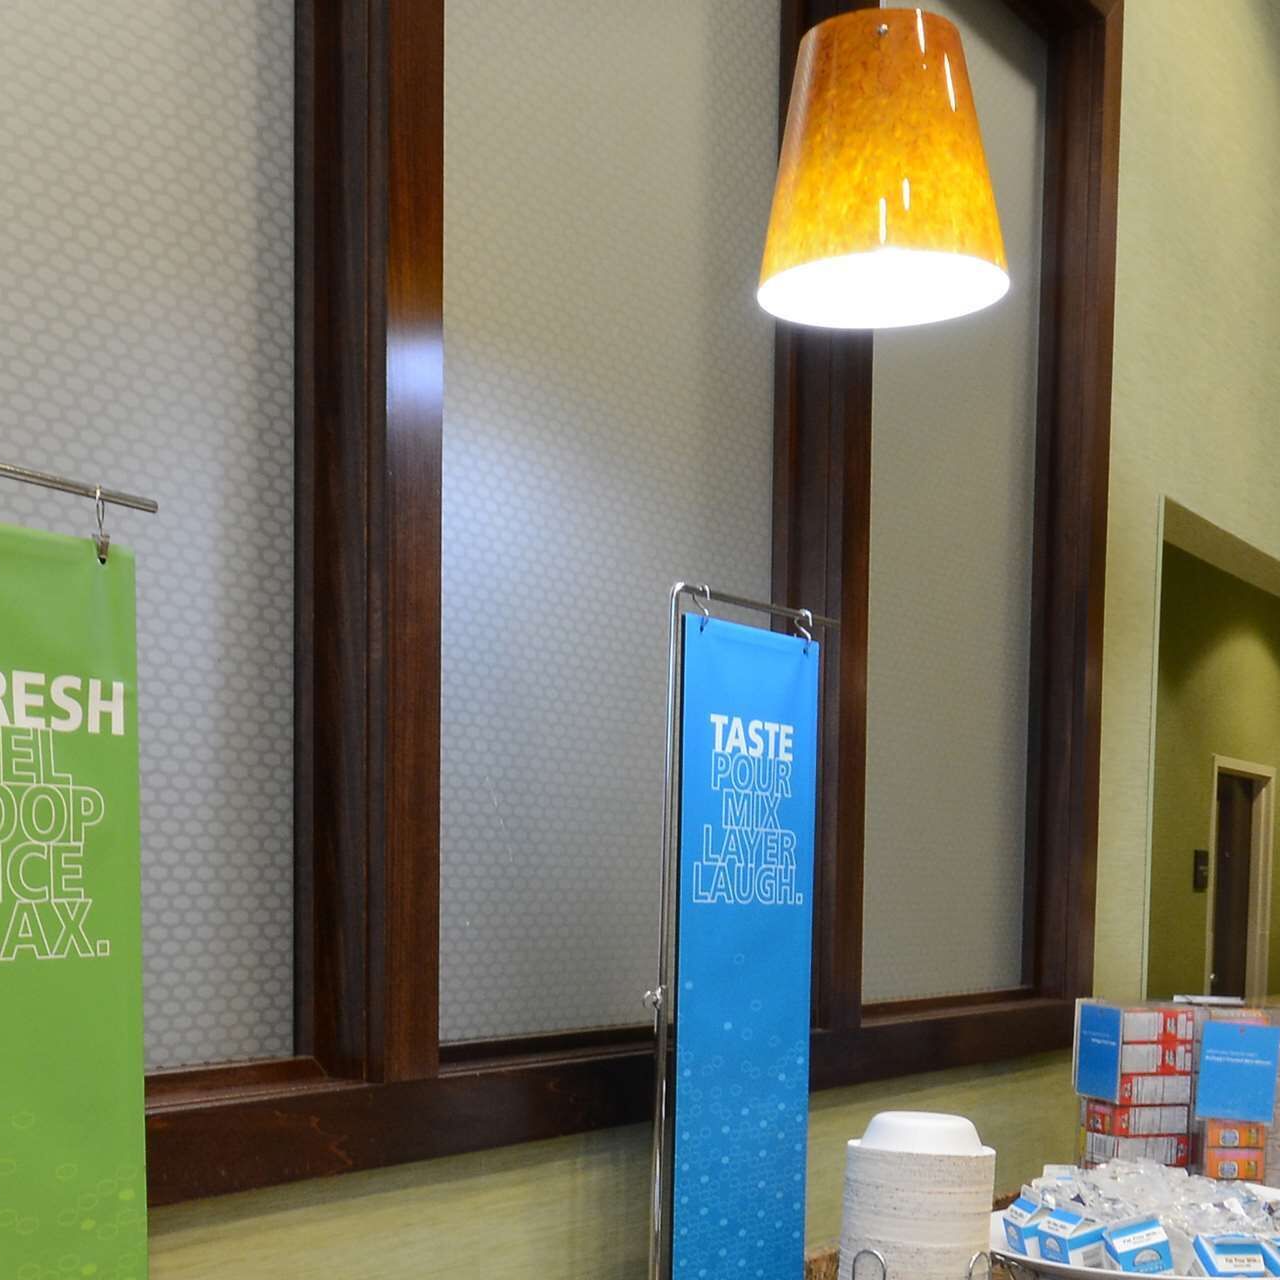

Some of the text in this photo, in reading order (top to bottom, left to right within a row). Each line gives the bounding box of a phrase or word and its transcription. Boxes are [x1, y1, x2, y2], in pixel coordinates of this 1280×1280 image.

[710, 713, 793, 762] TASTE
[711, 749, 792, 798] POUR
[722, 788, 780, 832] MIX
[703, 824, 796, 868] LAYER
[693, 861, 803, 905] LAUGH.
